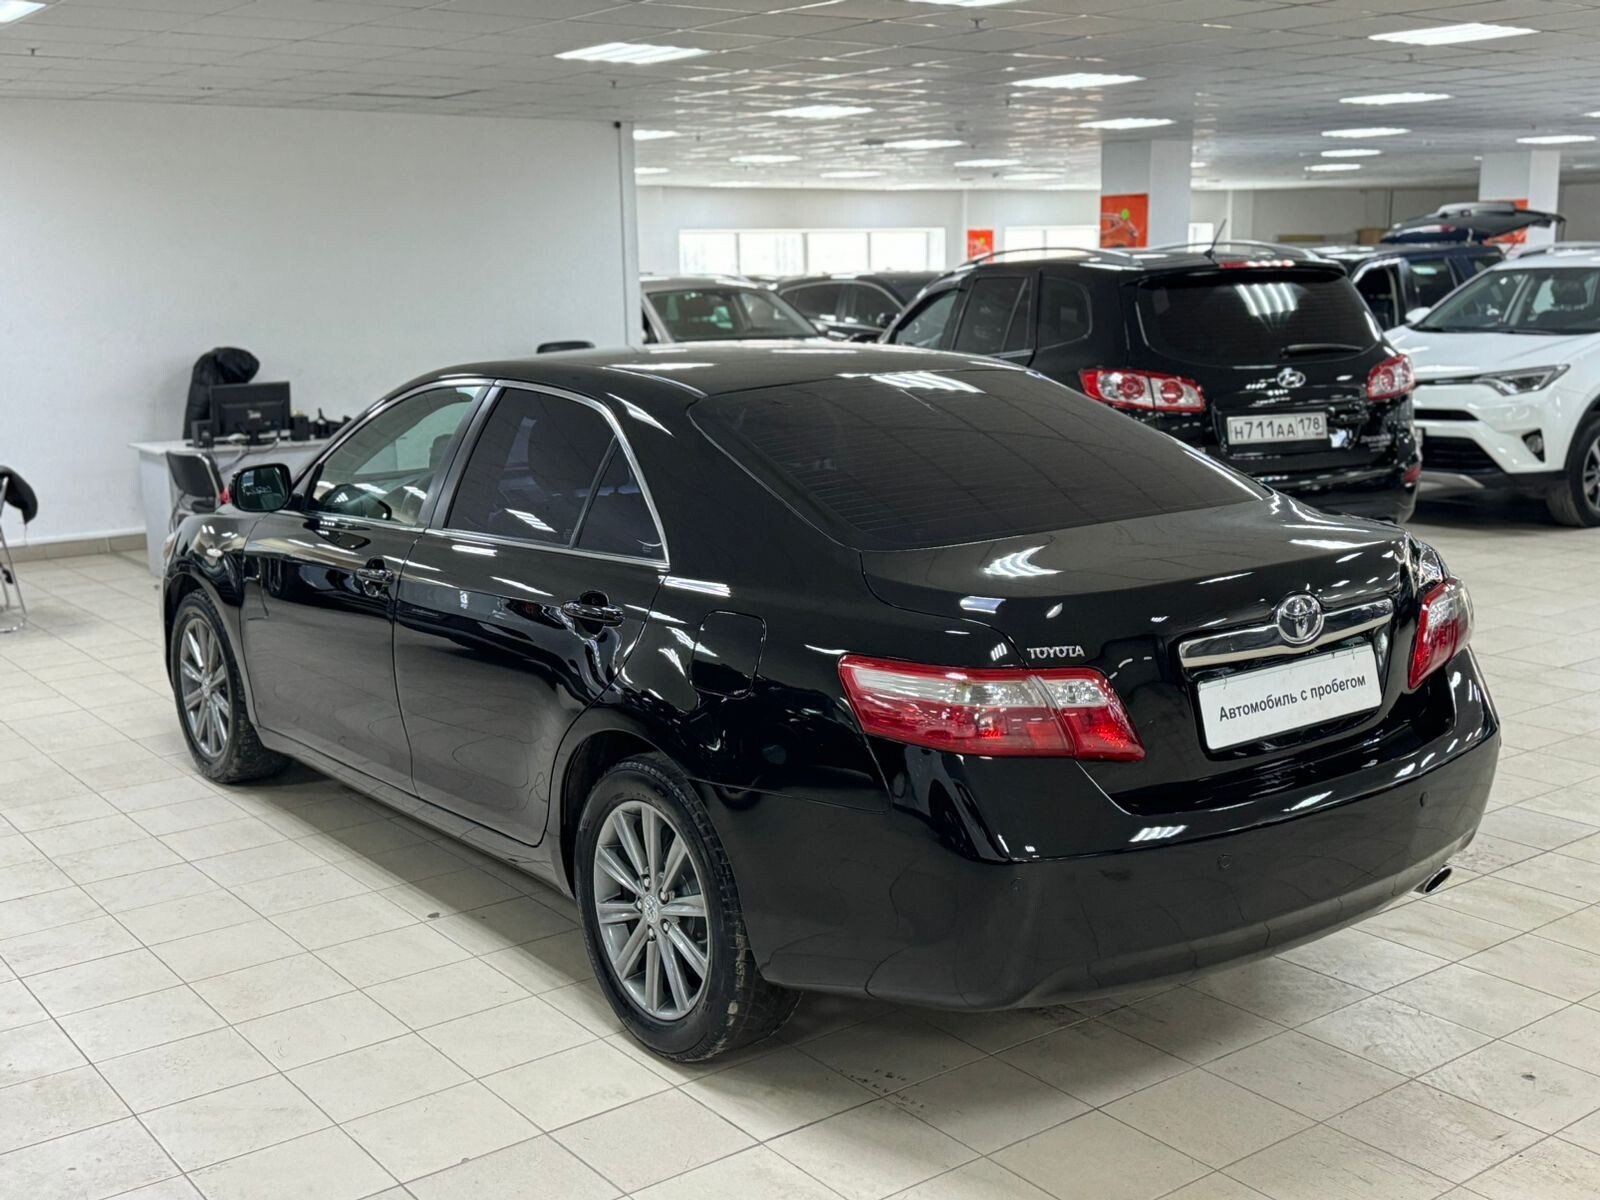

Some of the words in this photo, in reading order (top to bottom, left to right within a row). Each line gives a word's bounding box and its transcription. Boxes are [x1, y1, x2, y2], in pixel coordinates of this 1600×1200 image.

[1298, 417, 1320, 431] 178
[1026, 645, 1085, 659] TOYOTA
[1218, 692, 1298, 722] Автомобиль
[1300, 689, 1308, 701] с
[1310, 674, 1366, 700] пробегом
